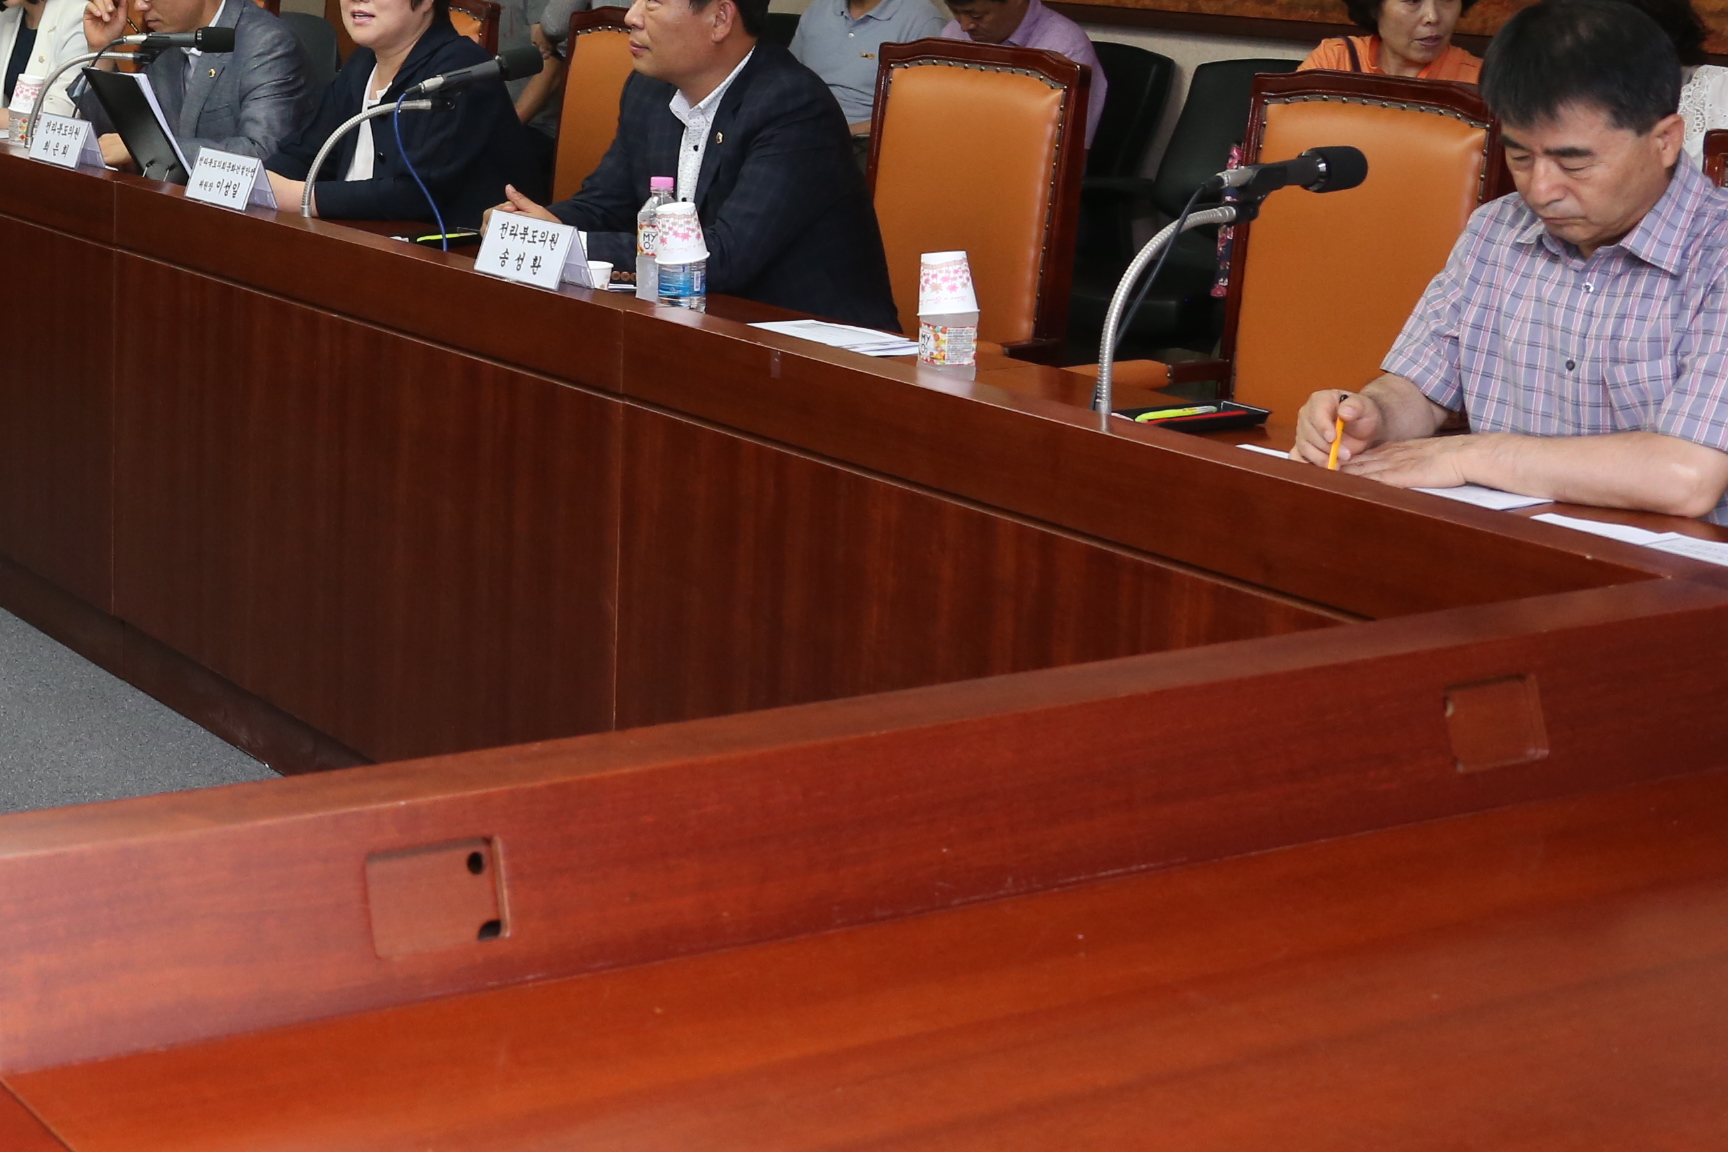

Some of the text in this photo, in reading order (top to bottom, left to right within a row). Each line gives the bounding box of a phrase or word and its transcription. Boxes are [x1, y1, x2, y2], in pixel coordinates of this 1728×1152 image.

[216, 178, 240, 199] 이성일
[499, 221, 560, 251] 전라북도의원
[643, 232, 657, 243] MY
